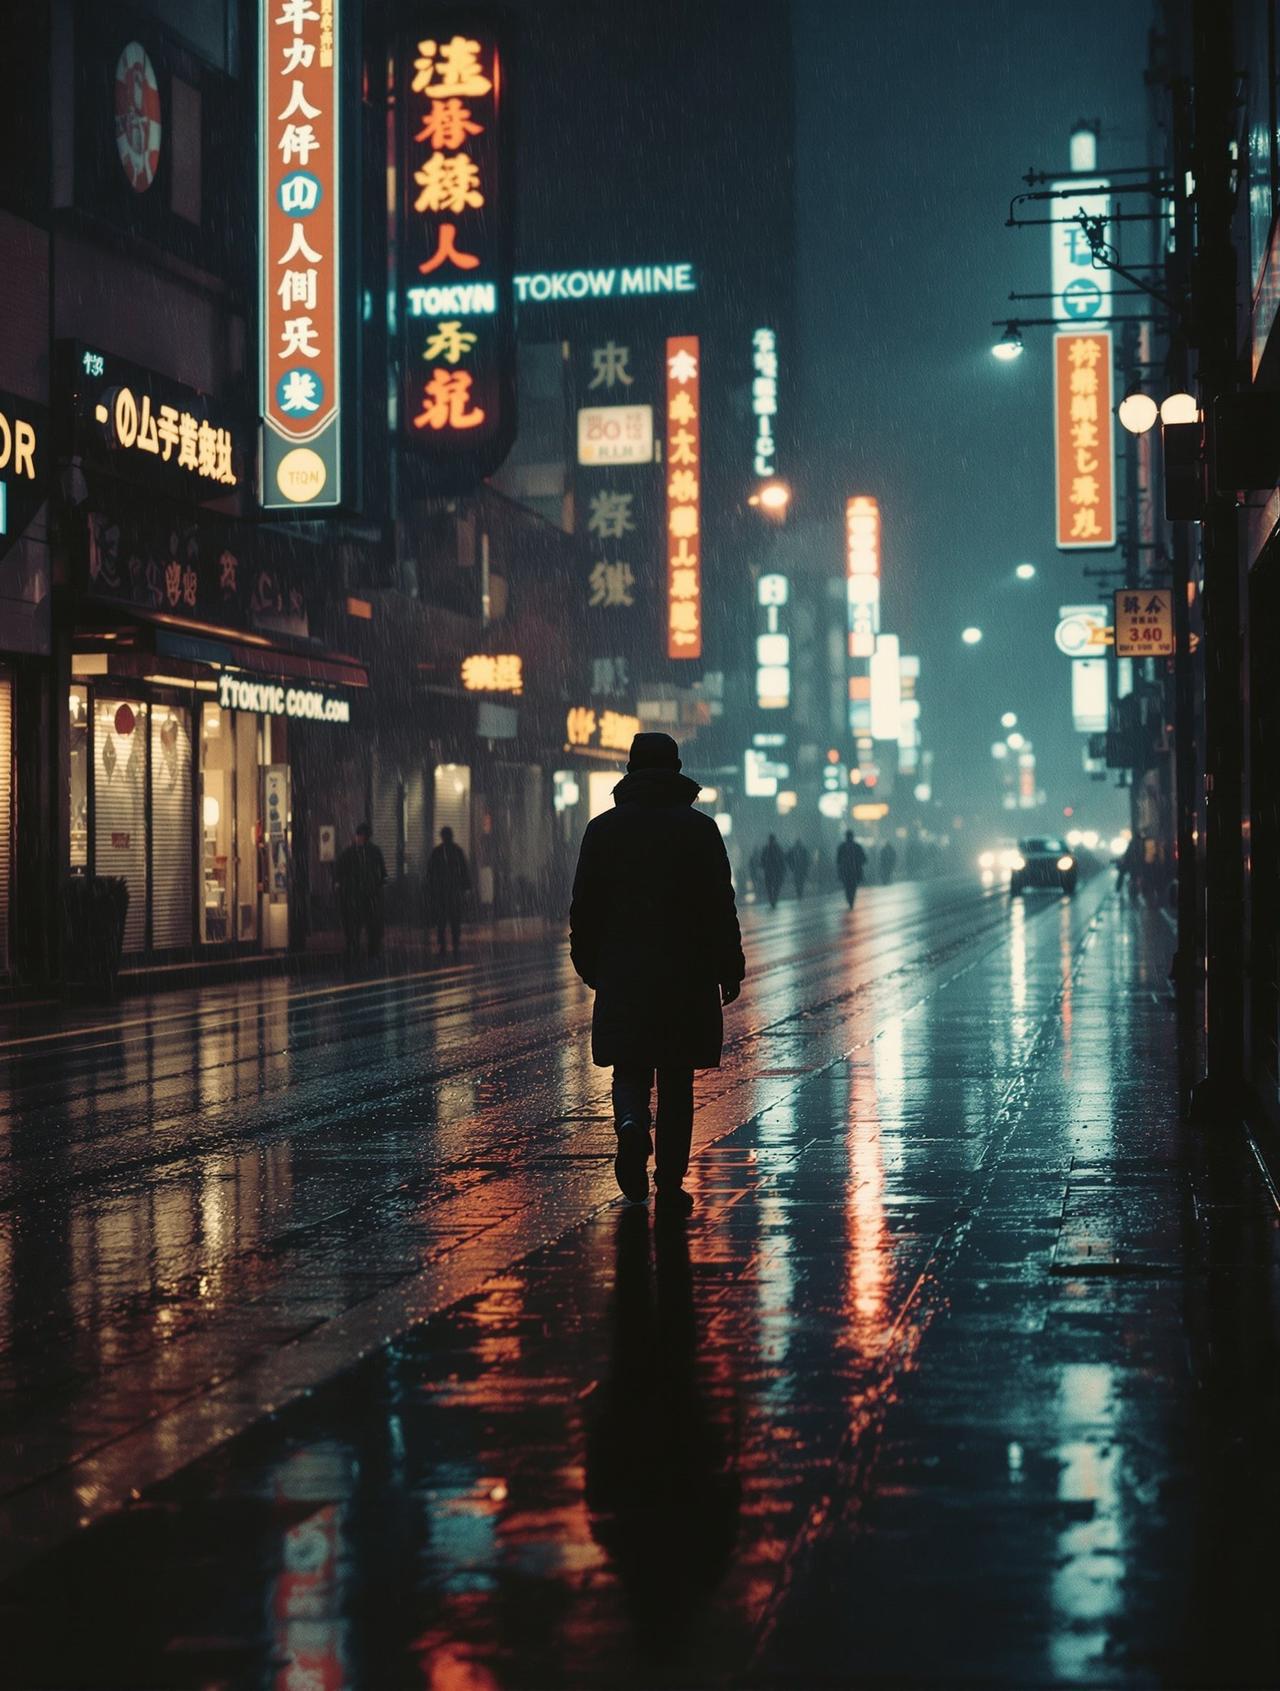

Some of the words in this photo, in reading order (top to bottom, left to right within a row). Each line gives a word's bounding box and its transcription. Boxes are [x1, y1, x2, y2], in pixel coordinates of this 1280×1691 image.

[408, 284, 495, 313] TOKYN
[514, 269, 616, 302] TOKOW
[621, 264, 696, 296] MINE
